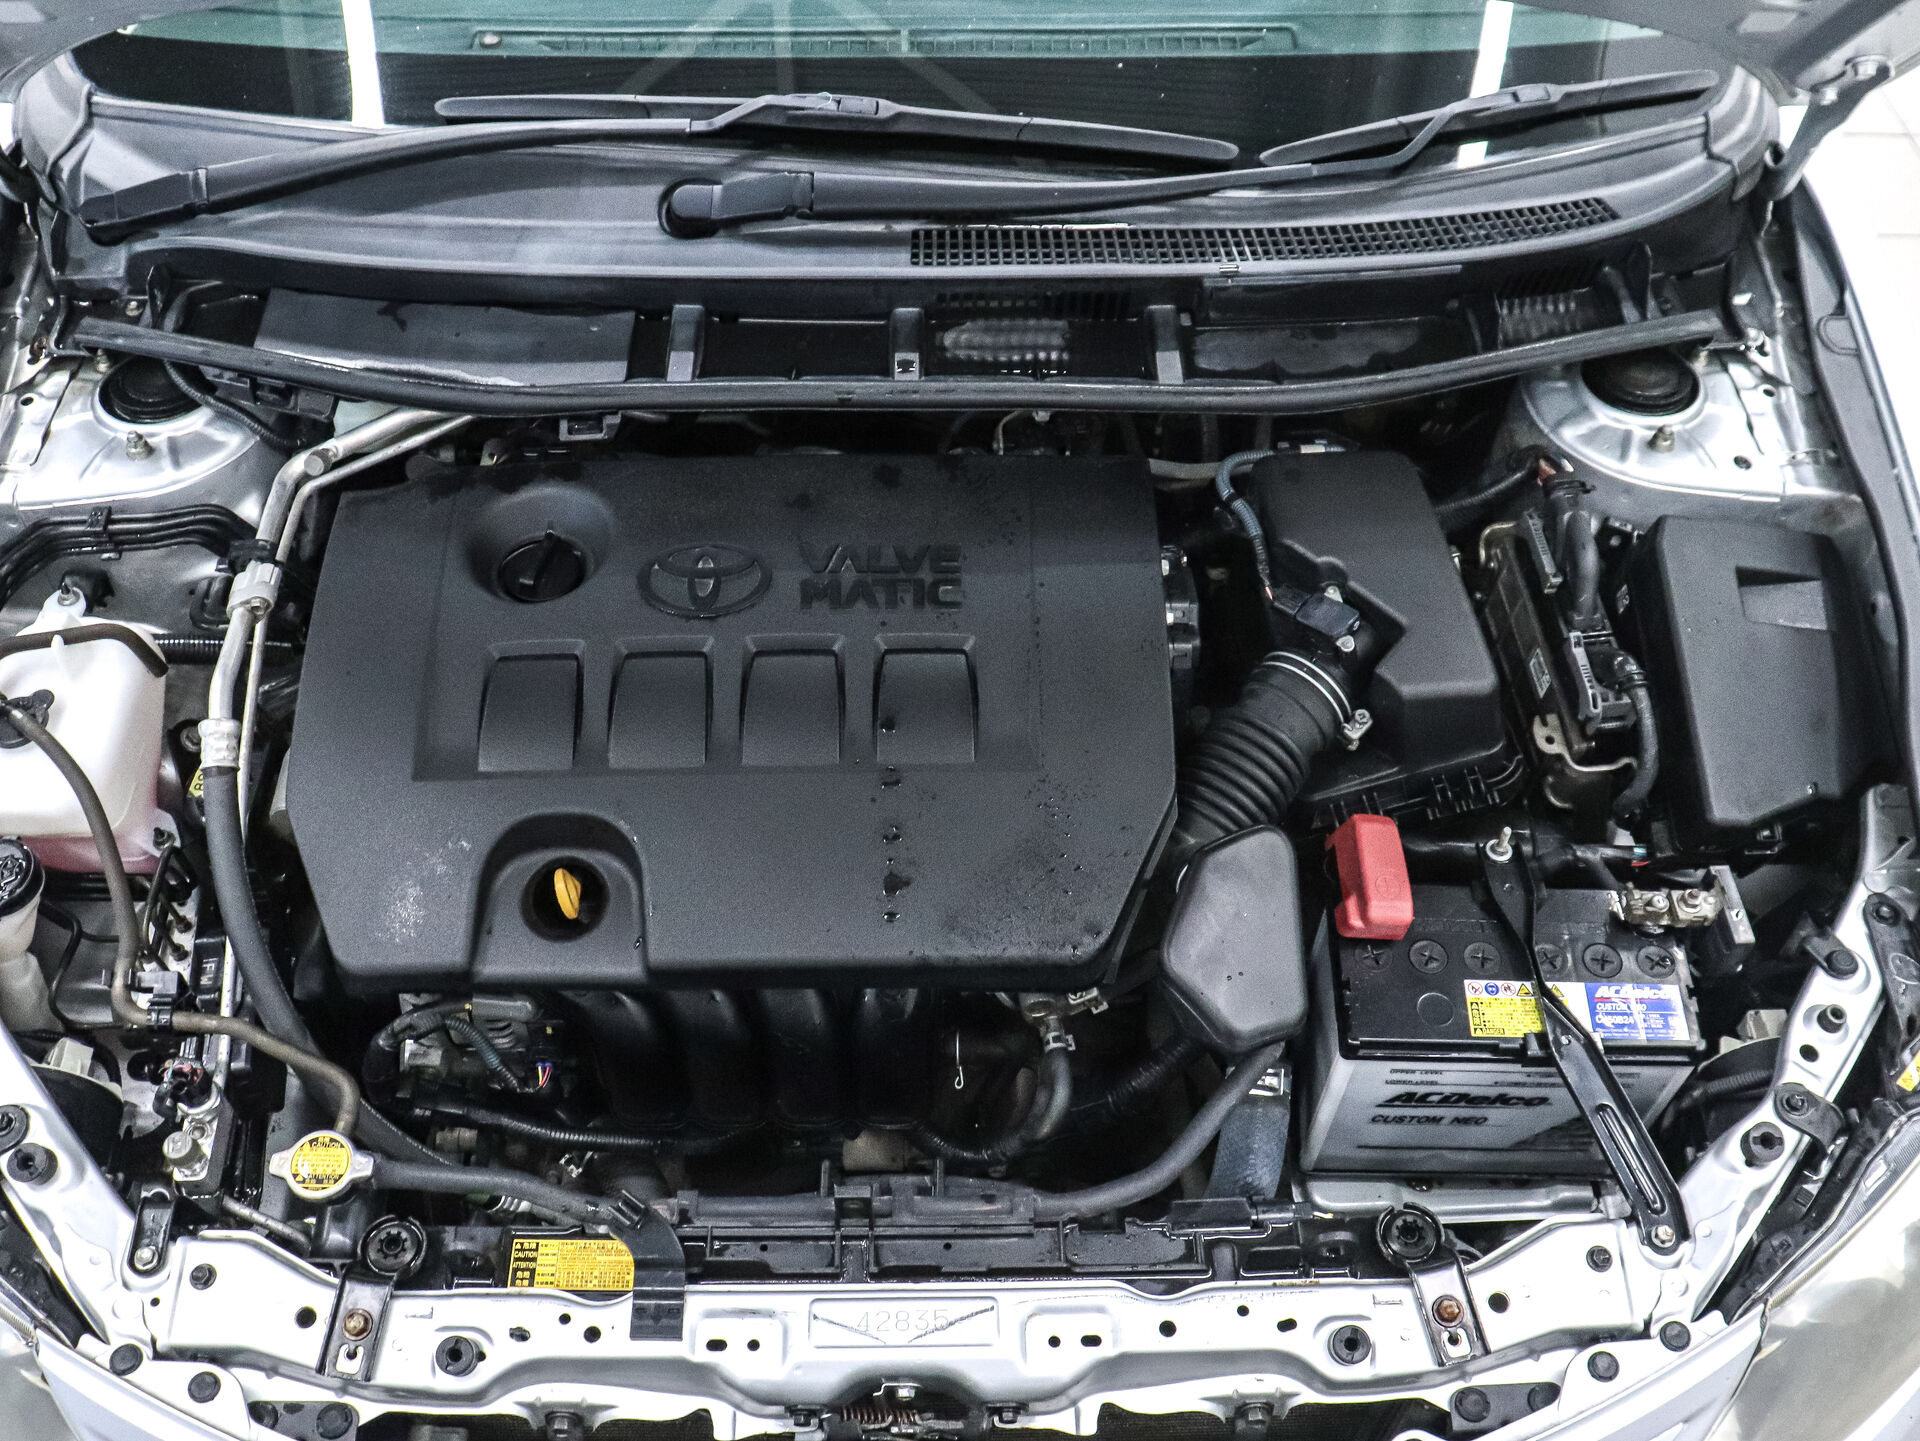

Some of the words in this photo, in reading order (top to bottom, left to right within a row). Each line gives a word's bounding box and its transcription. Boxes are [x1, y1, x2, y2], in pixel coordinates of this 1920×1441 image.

[801, 543, 962, 574] VALVE
[799, 578, 963, 610] MATIC
[1383, 1091, 1551, 1107] ACDelco
[1370, 1114, 1445, 1125] CUSTOM
[1450, 1116, 1489, 1125] NEO
[856, 1308, 950, 1332] 42835
